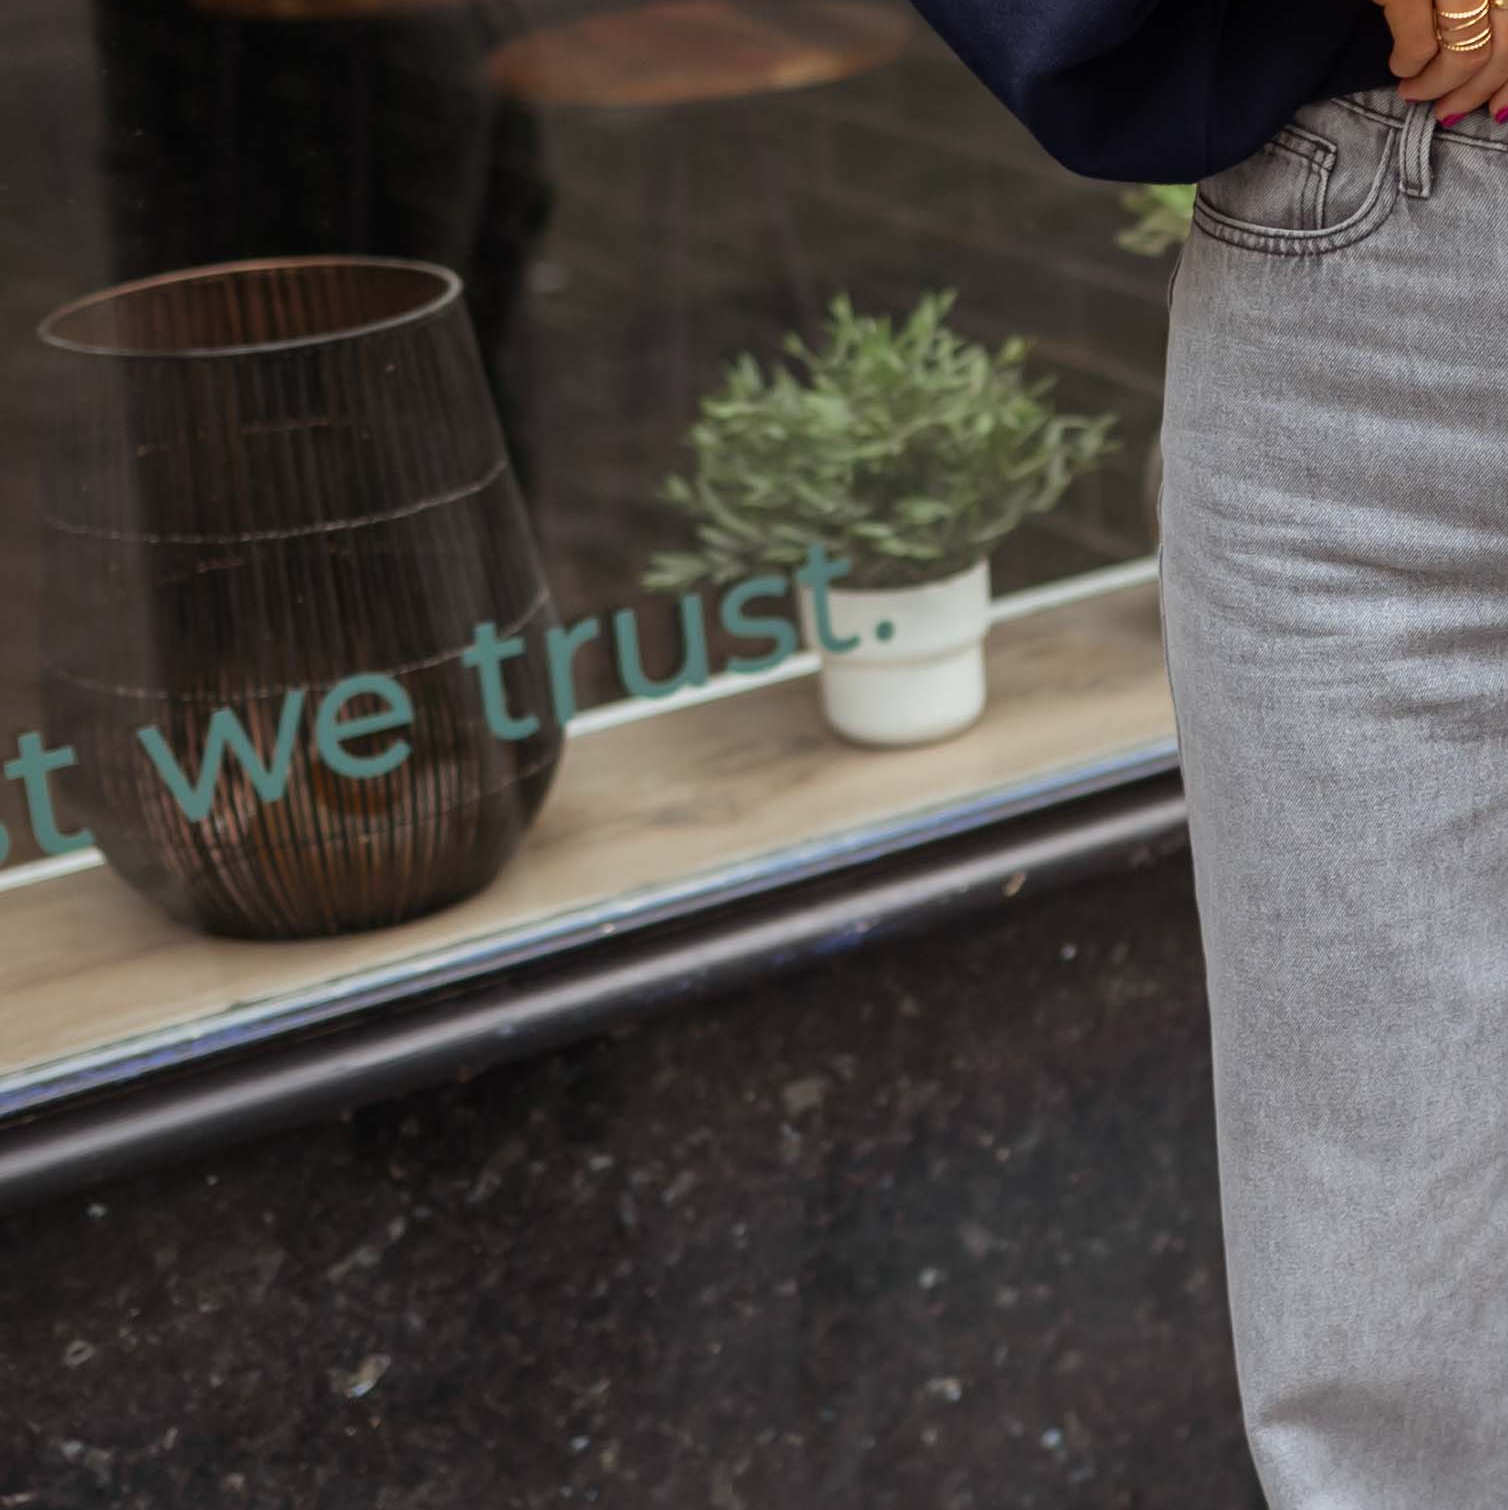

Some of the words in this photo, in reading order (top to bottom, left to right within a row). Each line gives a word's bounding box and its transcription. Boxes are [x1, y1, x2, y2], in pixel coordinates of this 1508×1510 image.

[0, 731, 95, 865] t
[137, 671, 414, 824] we
[462, 543, 894, 741] trust.
